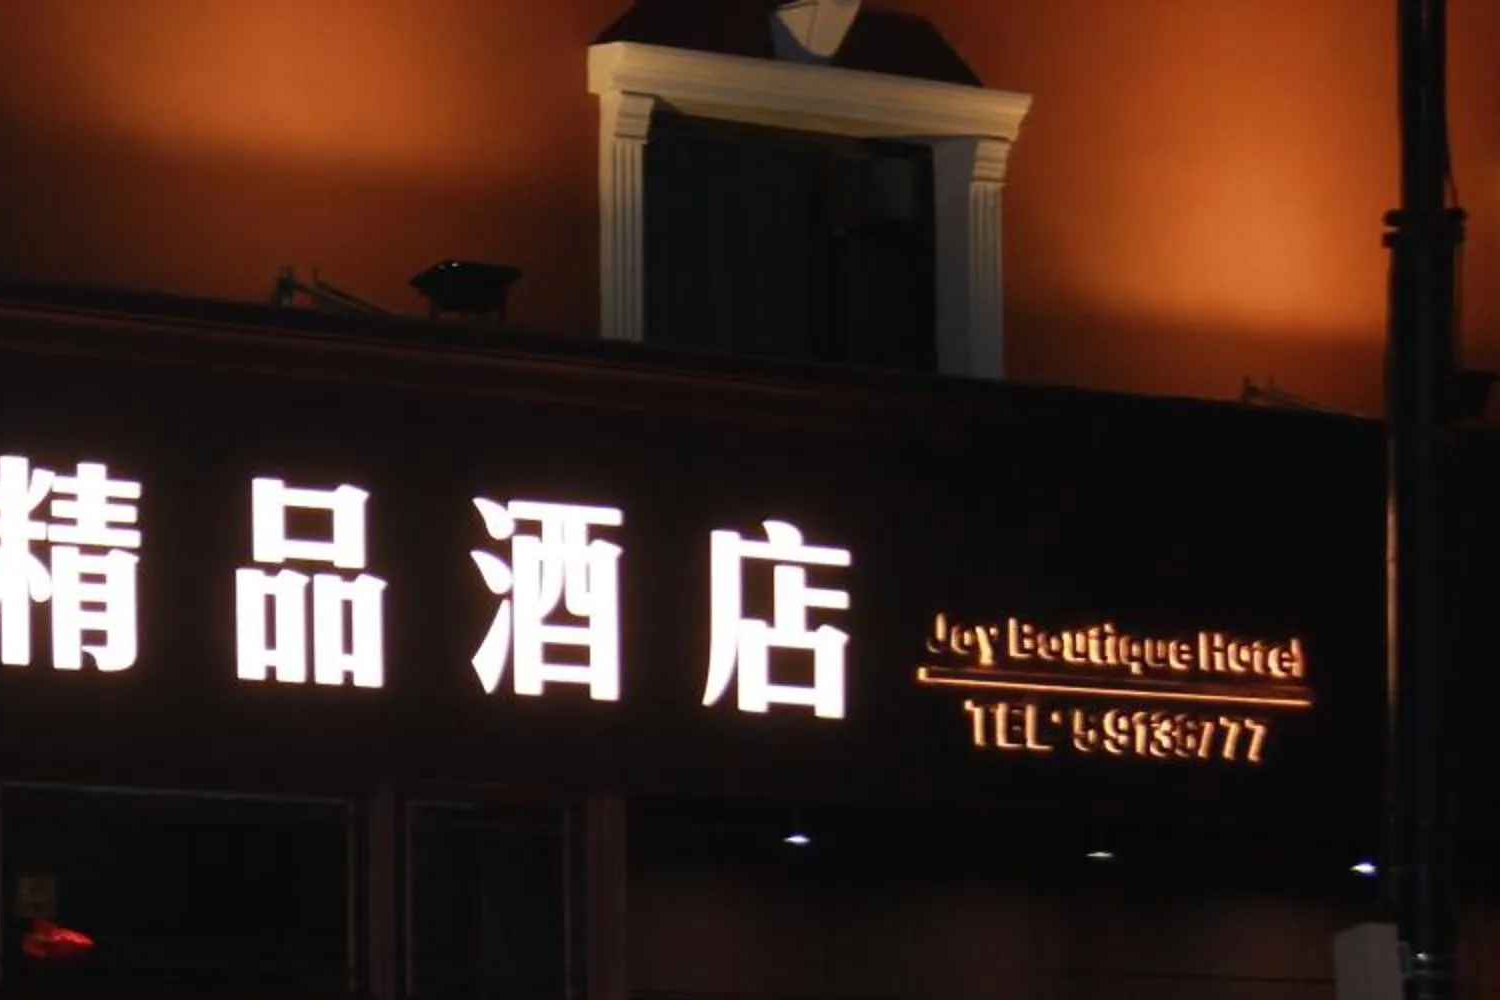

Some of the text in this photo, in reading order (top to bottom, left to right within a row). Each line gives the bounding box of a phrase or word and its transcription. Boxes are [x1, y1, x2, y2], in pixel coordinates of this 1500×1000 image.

[926, 612, 1305, 678] Joy Boutique Hotel
